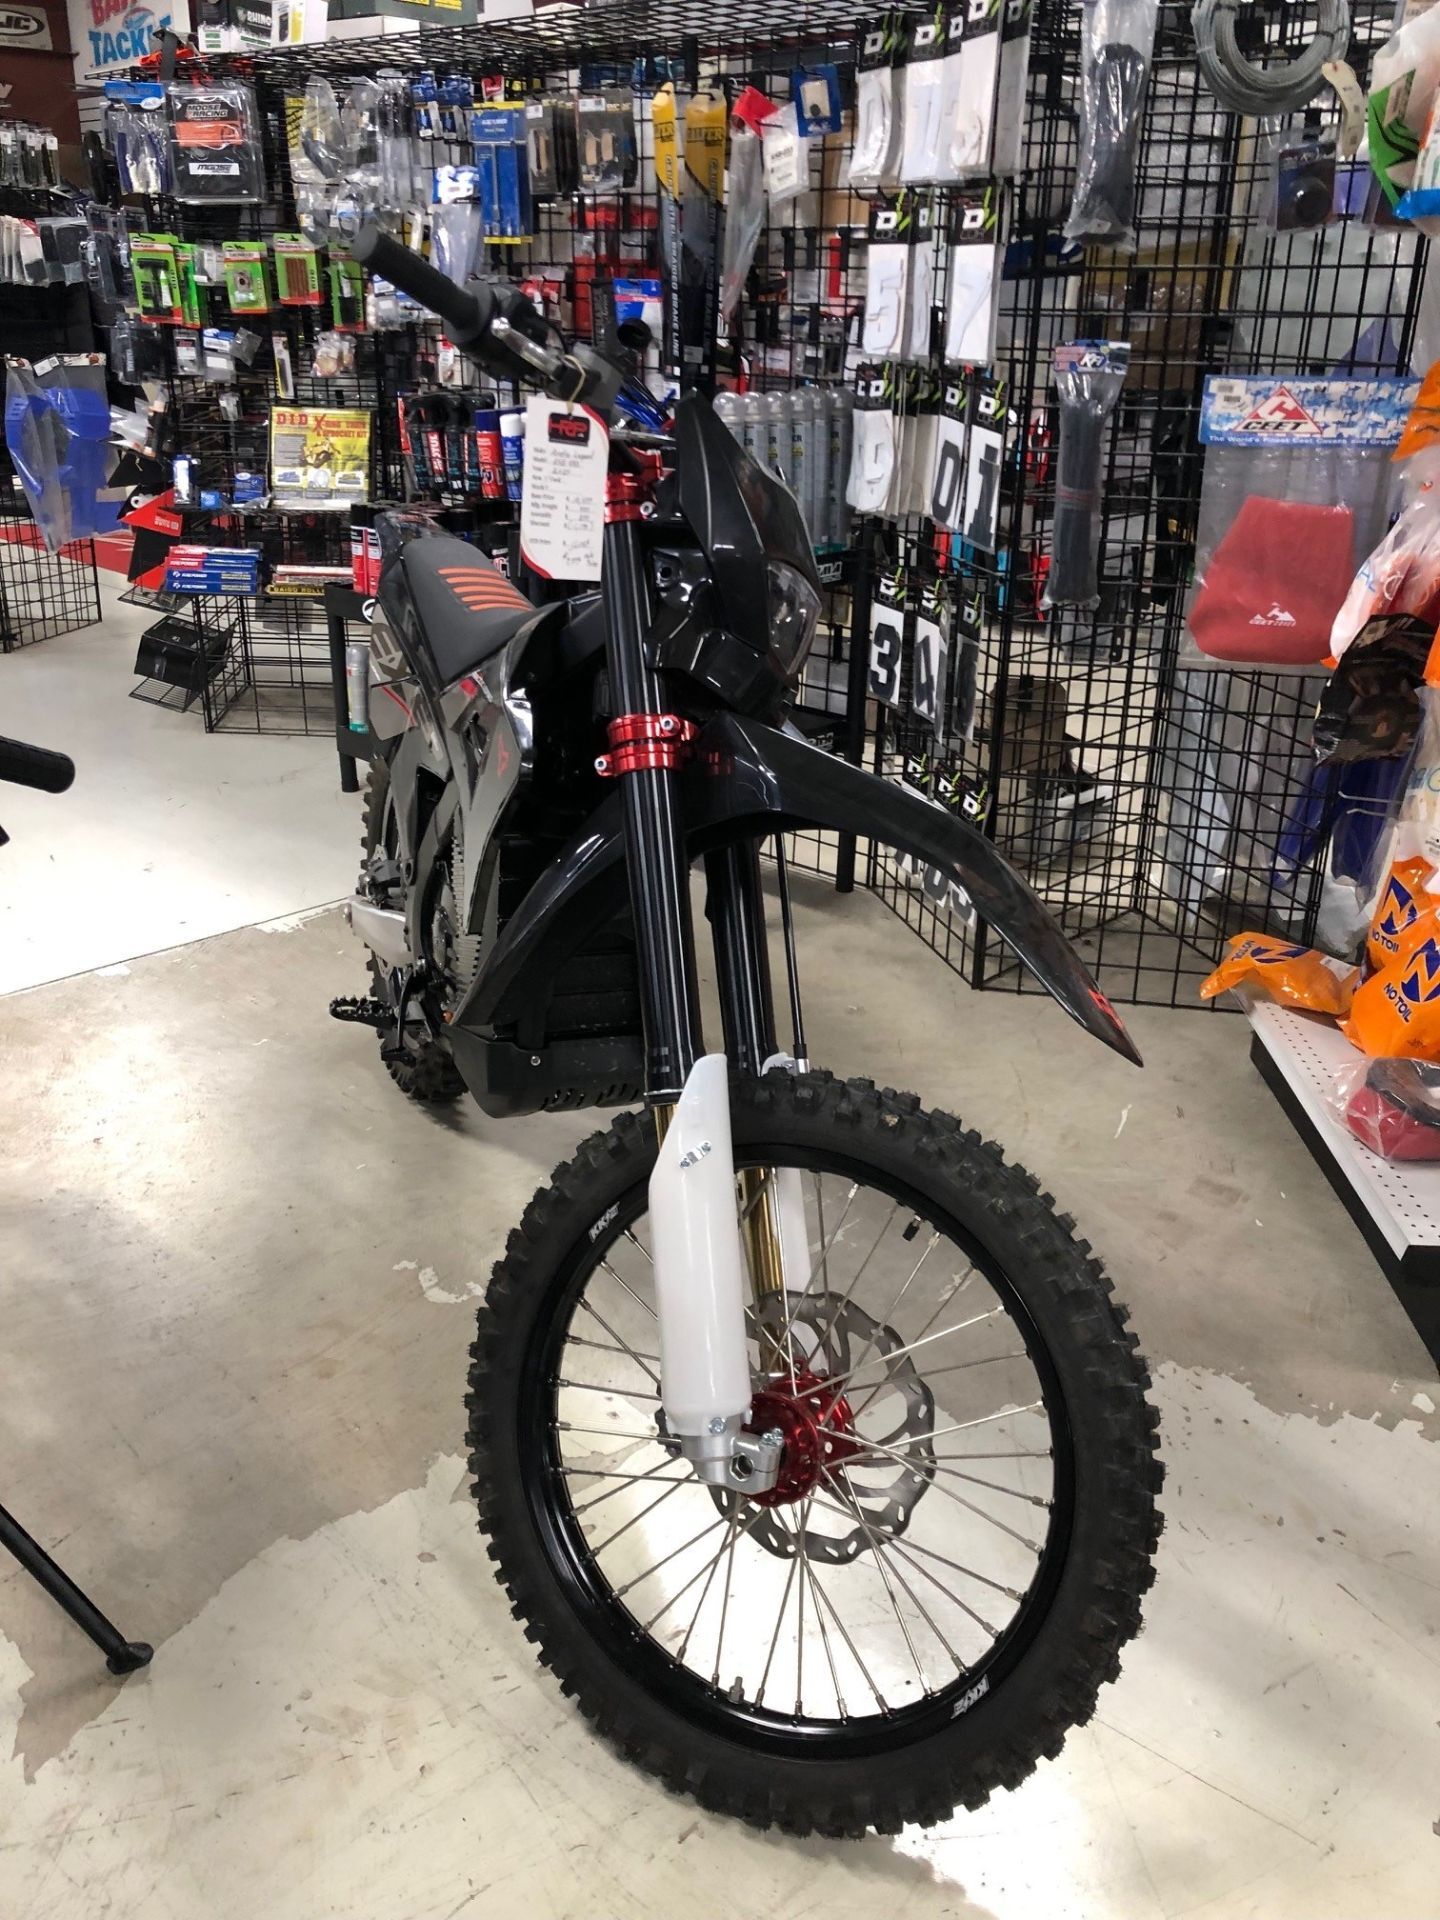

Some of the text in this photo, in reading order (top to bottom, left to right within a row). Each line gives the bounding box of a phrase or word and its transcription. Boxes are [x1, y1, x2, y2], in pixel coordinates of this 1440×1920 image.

[0, 15, 31, 31] JC
[671, 241, 679, 290] BRAIDED
[671, 293, 680, 329] BRAKE
[672, 332, 680, 357] LINE
[1243, 421, 1308, 430] CEET
[870, 622, 902, 701] 3
[1383, 982, 1413, 1023] NO TOIL
